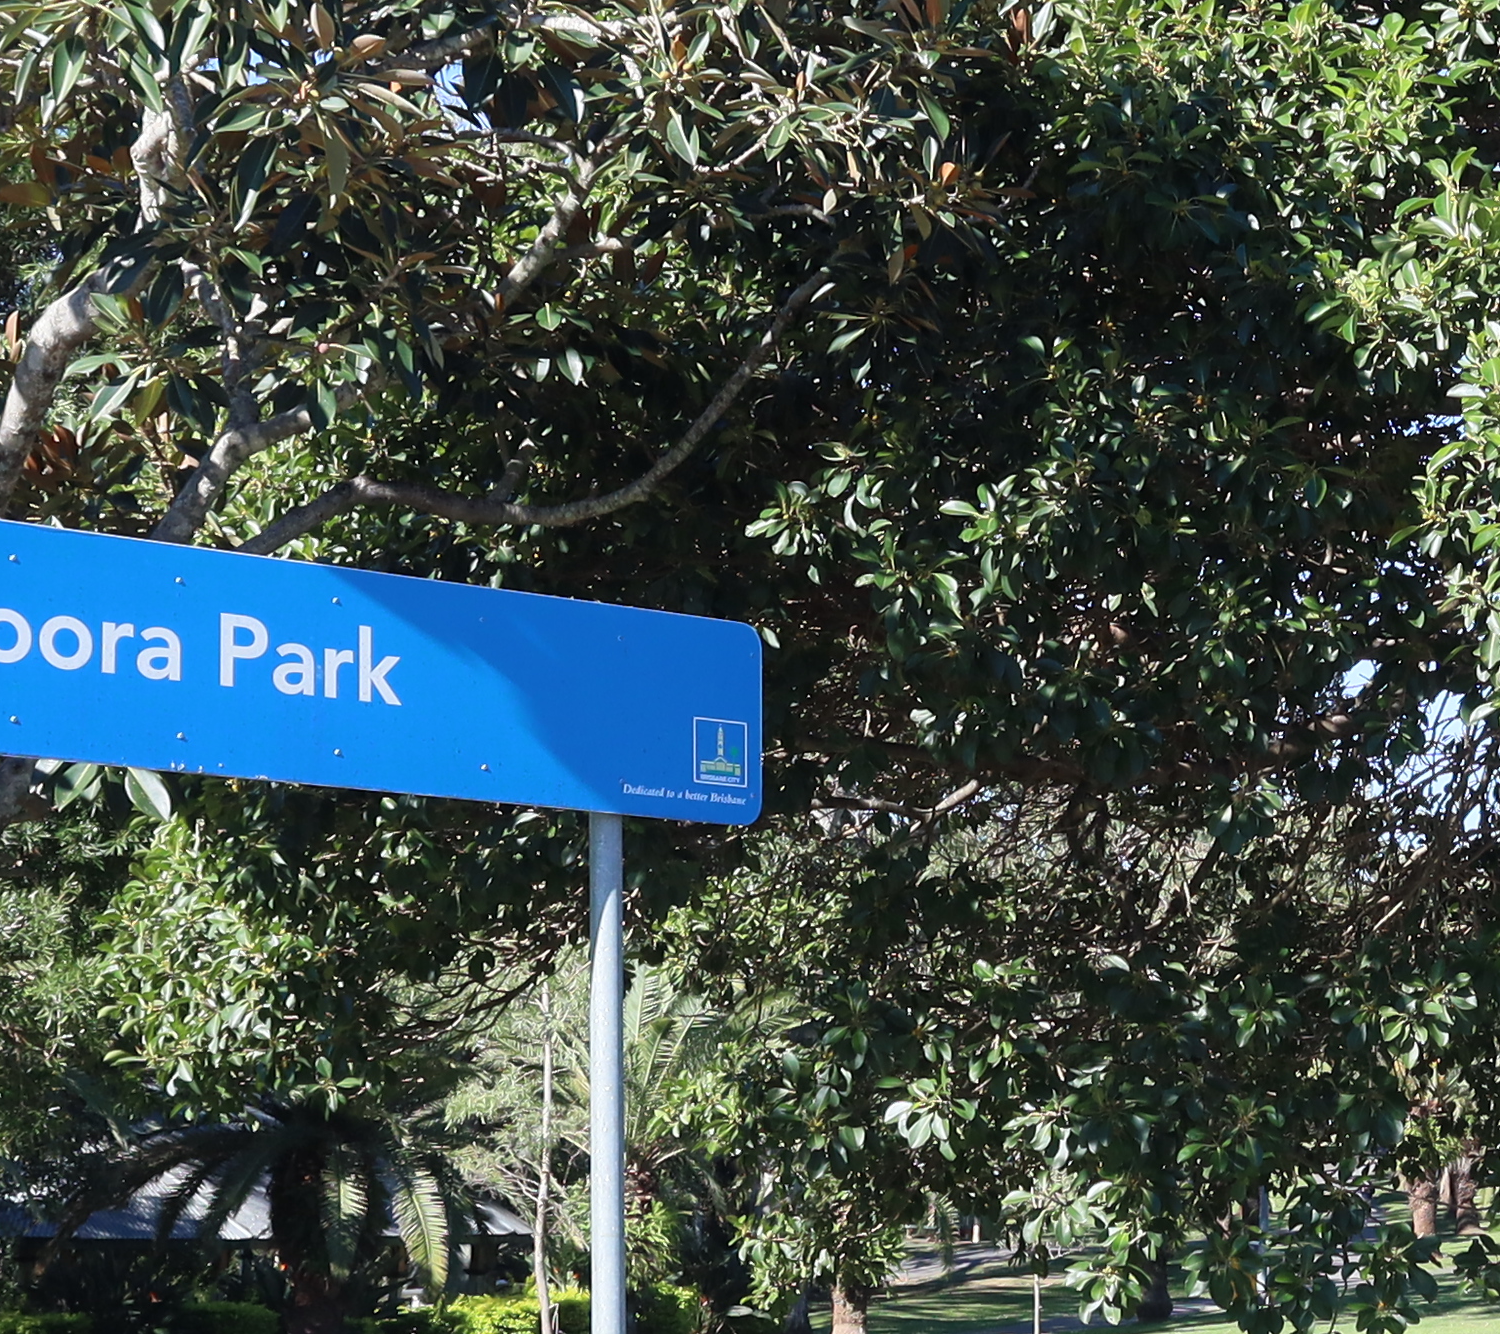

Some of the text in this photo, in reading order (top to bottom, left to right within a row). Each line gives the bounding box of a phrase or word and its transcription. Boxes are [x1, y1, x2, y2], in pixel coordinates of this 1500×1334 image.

[219, 612, 402, 706] Park
[623, 783, 665, 797] Dedicated
[666, 789, 675, 798] to
[685, 789, 708, 802] better
[709, 792, 746, 805] Brisbane
